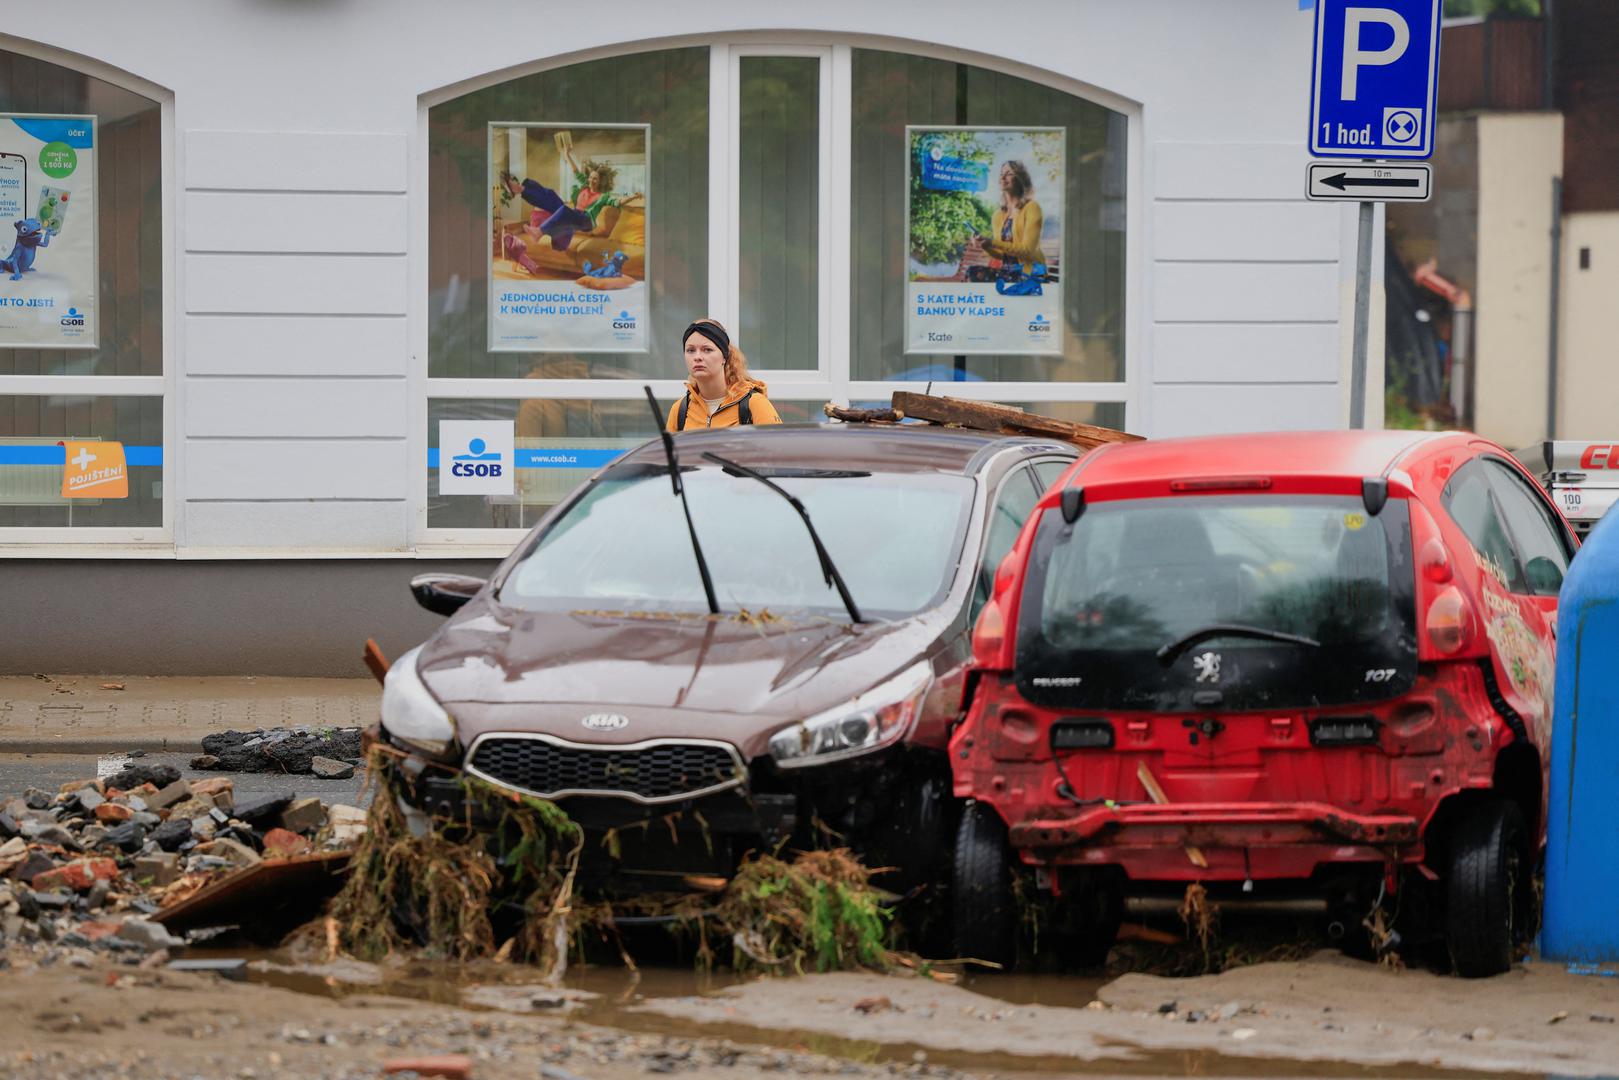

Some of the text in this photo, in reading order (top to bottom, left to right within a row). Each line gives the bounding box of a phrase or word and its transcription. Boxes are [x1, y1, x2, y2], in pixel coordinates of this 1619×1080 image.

[1341, 7, 1410, 101] P
[67, 129, 86, 137] ÚČET
[1322, 122, 1376, 145] 1 hod.
[1373, 170, 1382, 178] 10
[10, 298, 24, 307] TO
[27, 296, 54, 307] JISTÍ
[500, 292, 611, 303] JEDNODUCHÁ CESTA
[917, 292, 985, 304] S KATE MÁTE
[500, 304, 604, 315] K NOVÉMU BYDLENÍ
[917, 307, 1005, 316] BANKU V KAPSE
[928, 332, 953, 342] Kate
[531, 455, 577, 463] www.csob.cz
[69, 464, 123, 486] POJIŠTĚNÍ
[451, 462, 502, 477] ČSOB
[1563, 494, 1581, 504] 100
[1364, 668, 1397, 682] 107
[1032, 677, 1082, 687] PEUGEOT
[585, 714, 625, 728] KIA
